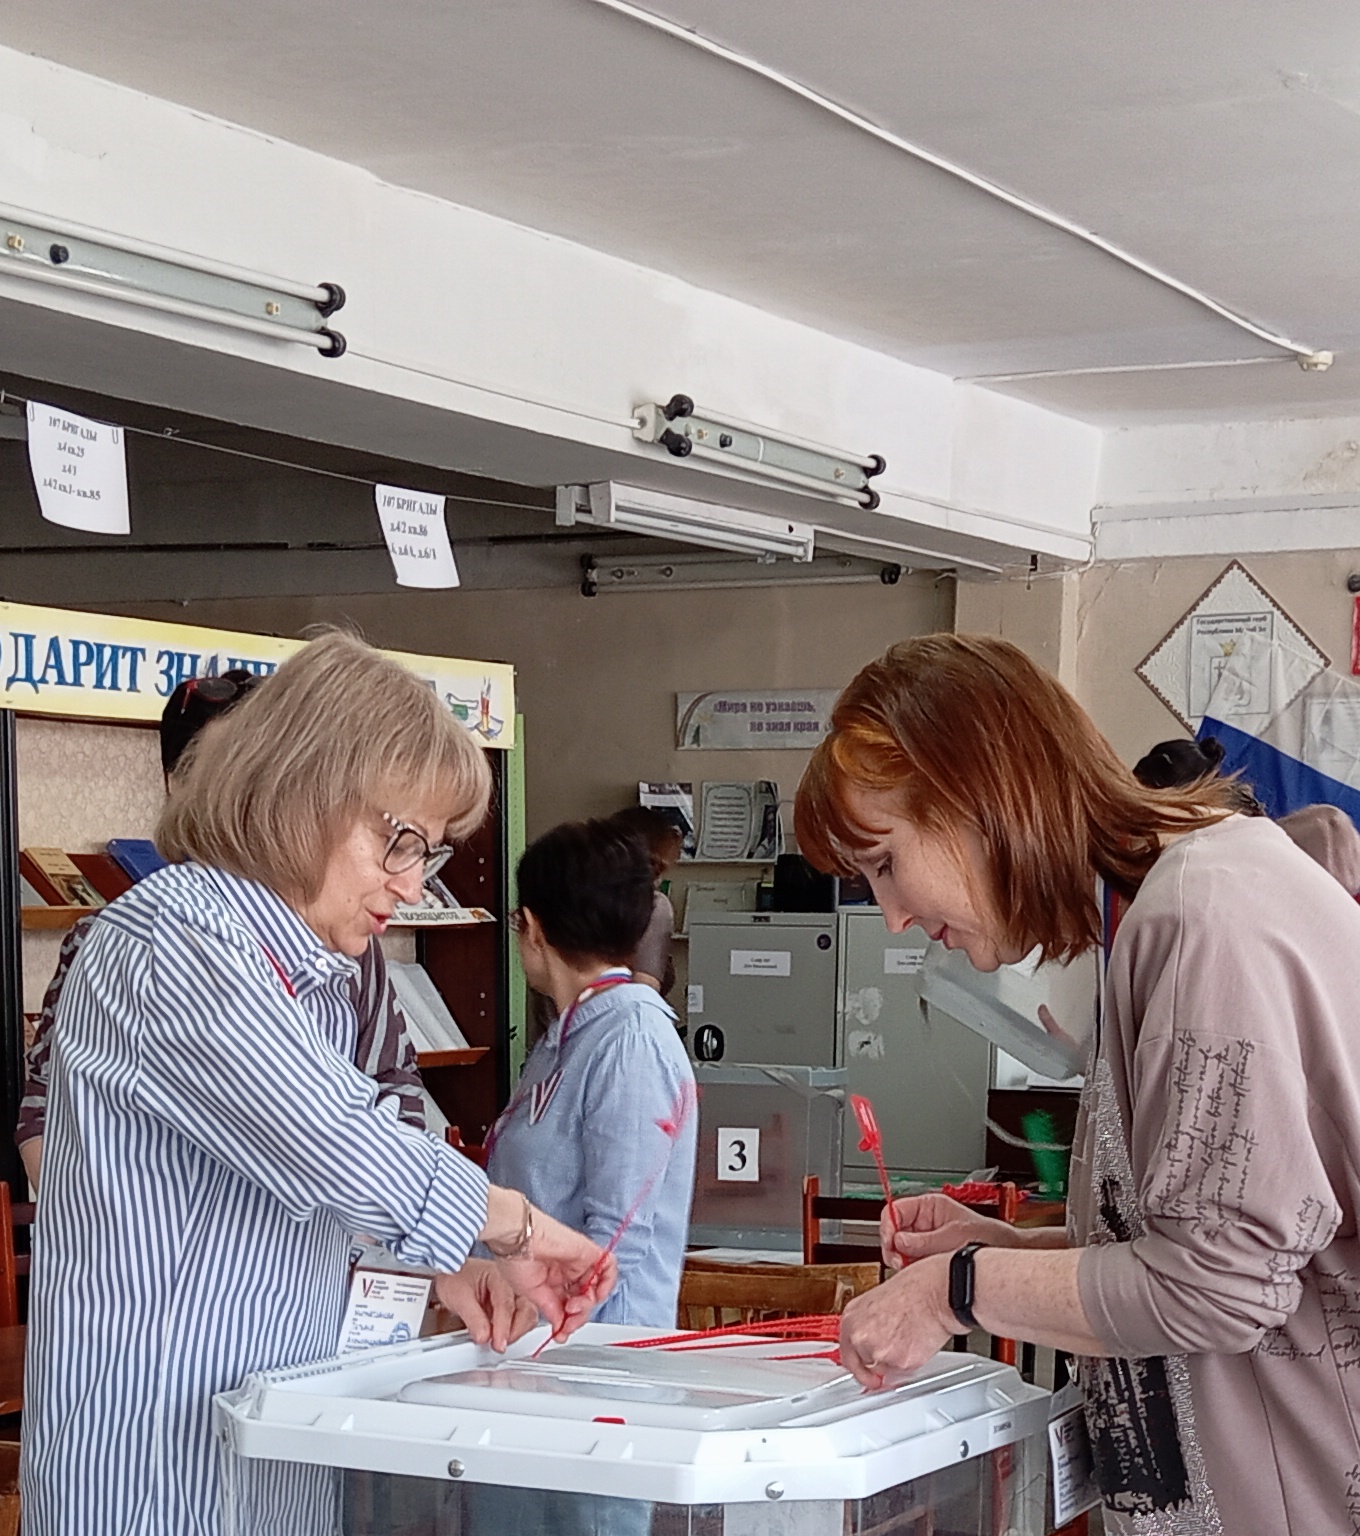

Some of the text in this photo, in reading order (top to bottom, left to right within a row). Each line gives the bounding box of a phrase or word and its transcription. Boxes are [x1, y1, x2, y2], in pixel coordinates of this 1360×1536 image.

[396, 497, 438, 516] БРИГАДЫ
[5, 632, 146, 694] ДАРИТ
[728, 1139, 747, 1172] 3
